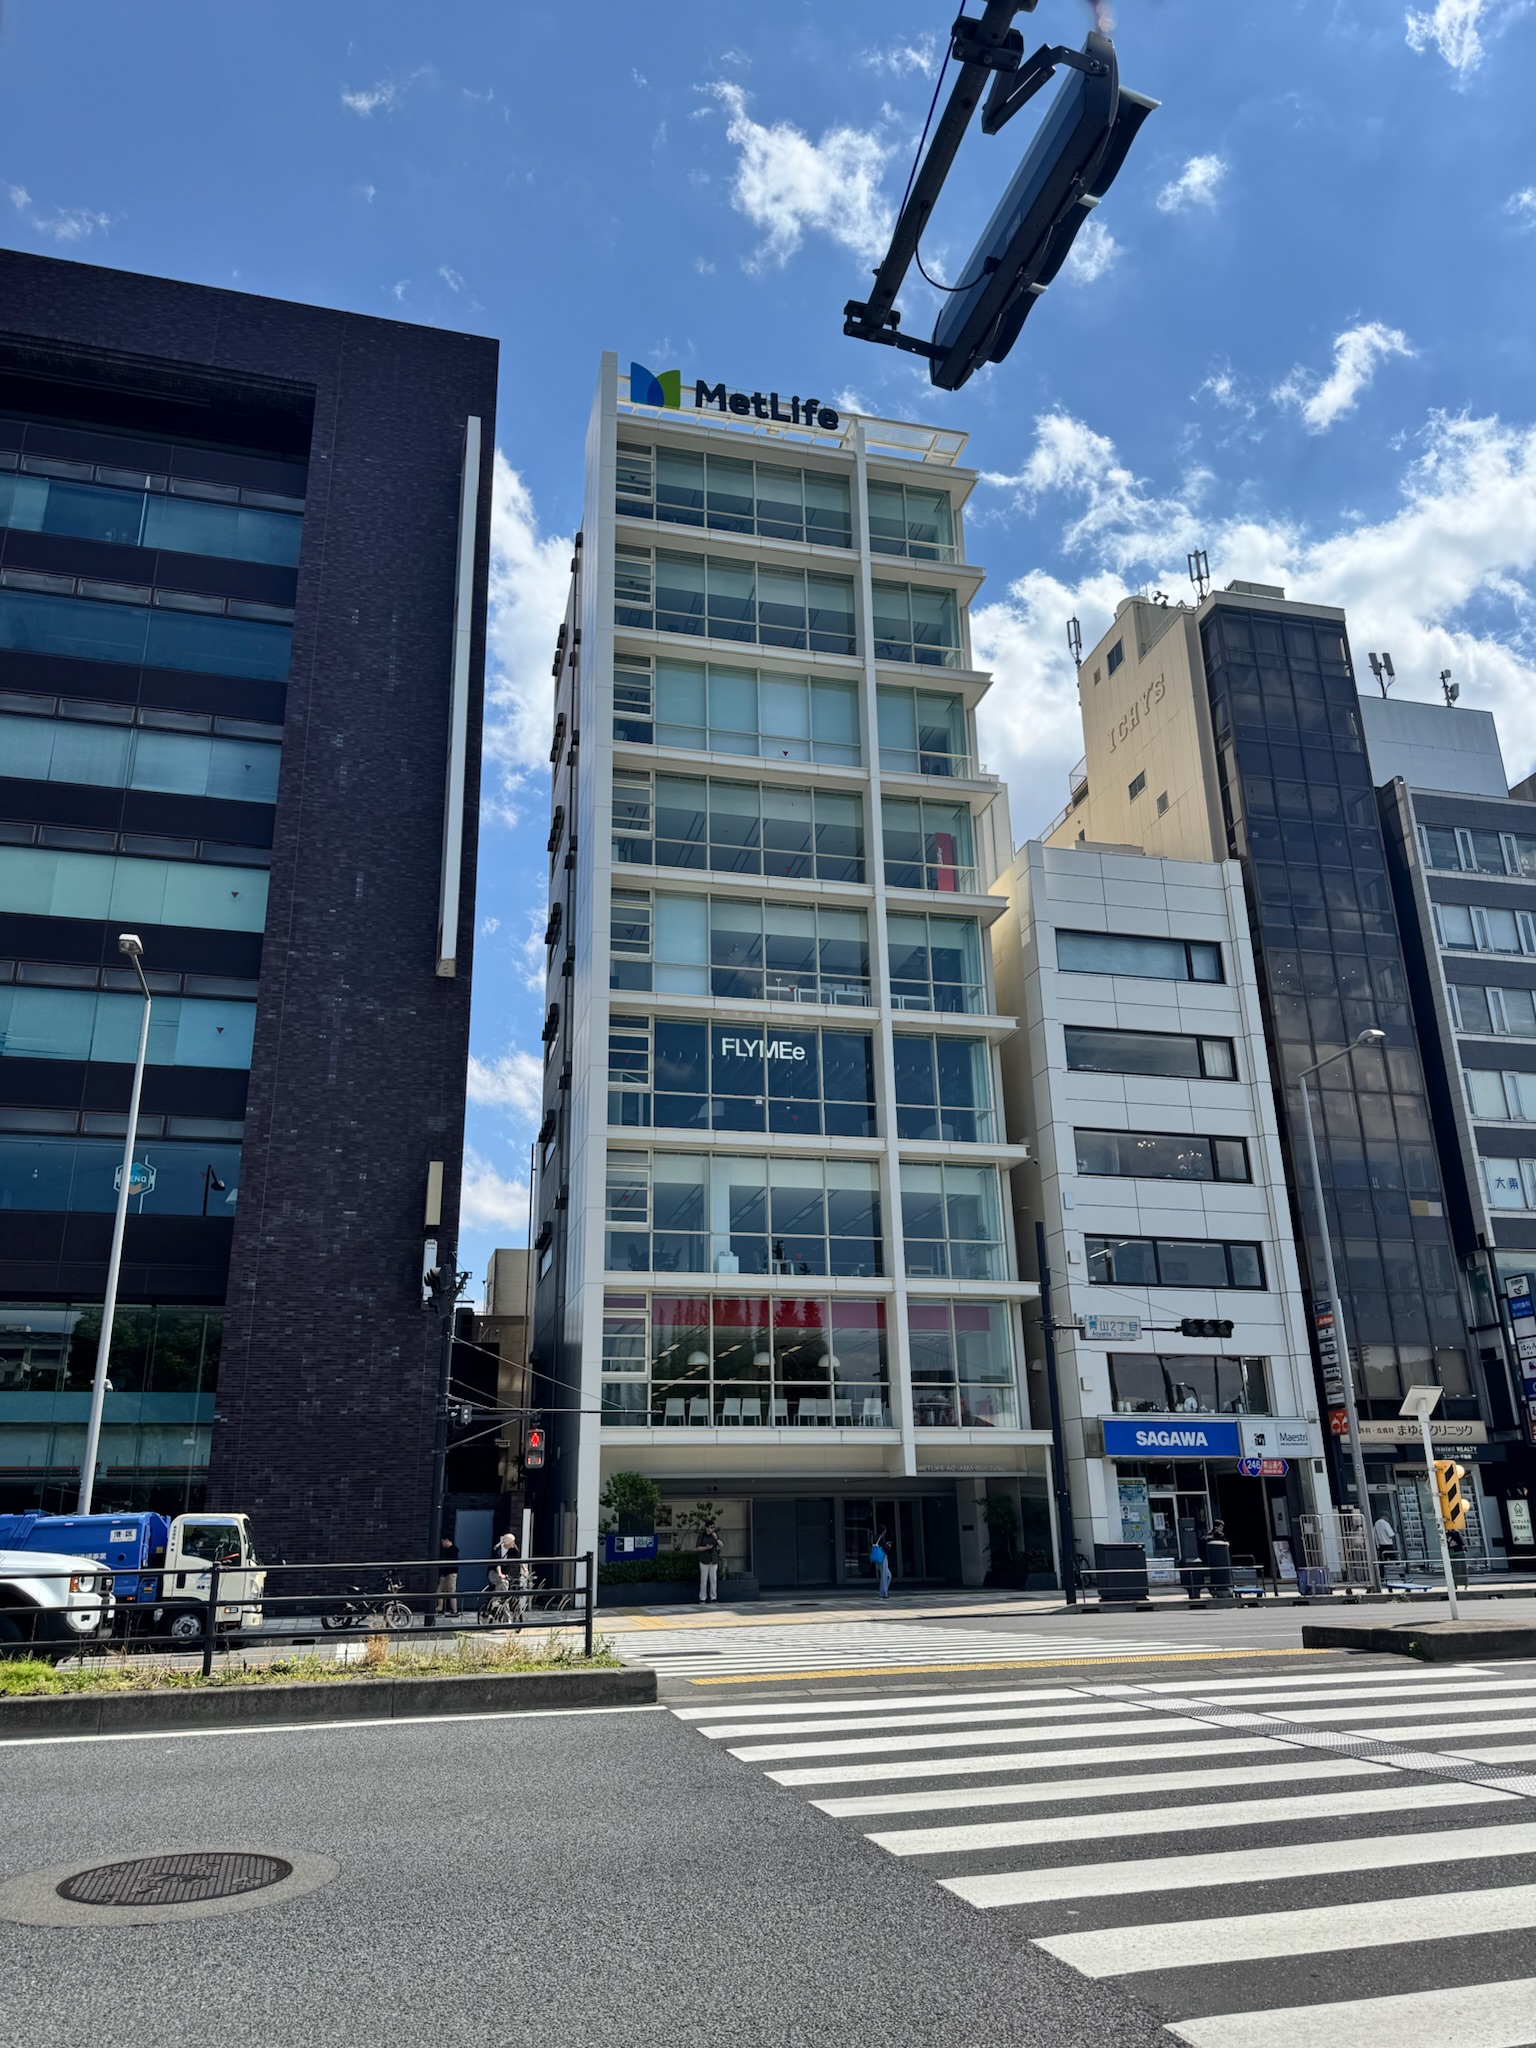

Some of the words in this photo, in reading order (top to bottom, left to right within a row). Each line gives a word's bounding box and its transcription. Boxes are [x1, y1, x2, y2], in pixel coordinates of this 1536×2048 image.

[695, 379, 839, 430] MetLife
[721, 1037, 806, 1061] FLYMEe
[1135, 1430, 1209, 1447] SAGAWA
[1279, 1431, 1309, 1442] Maestri
[1246, 1460, 1261, 1470] 246
